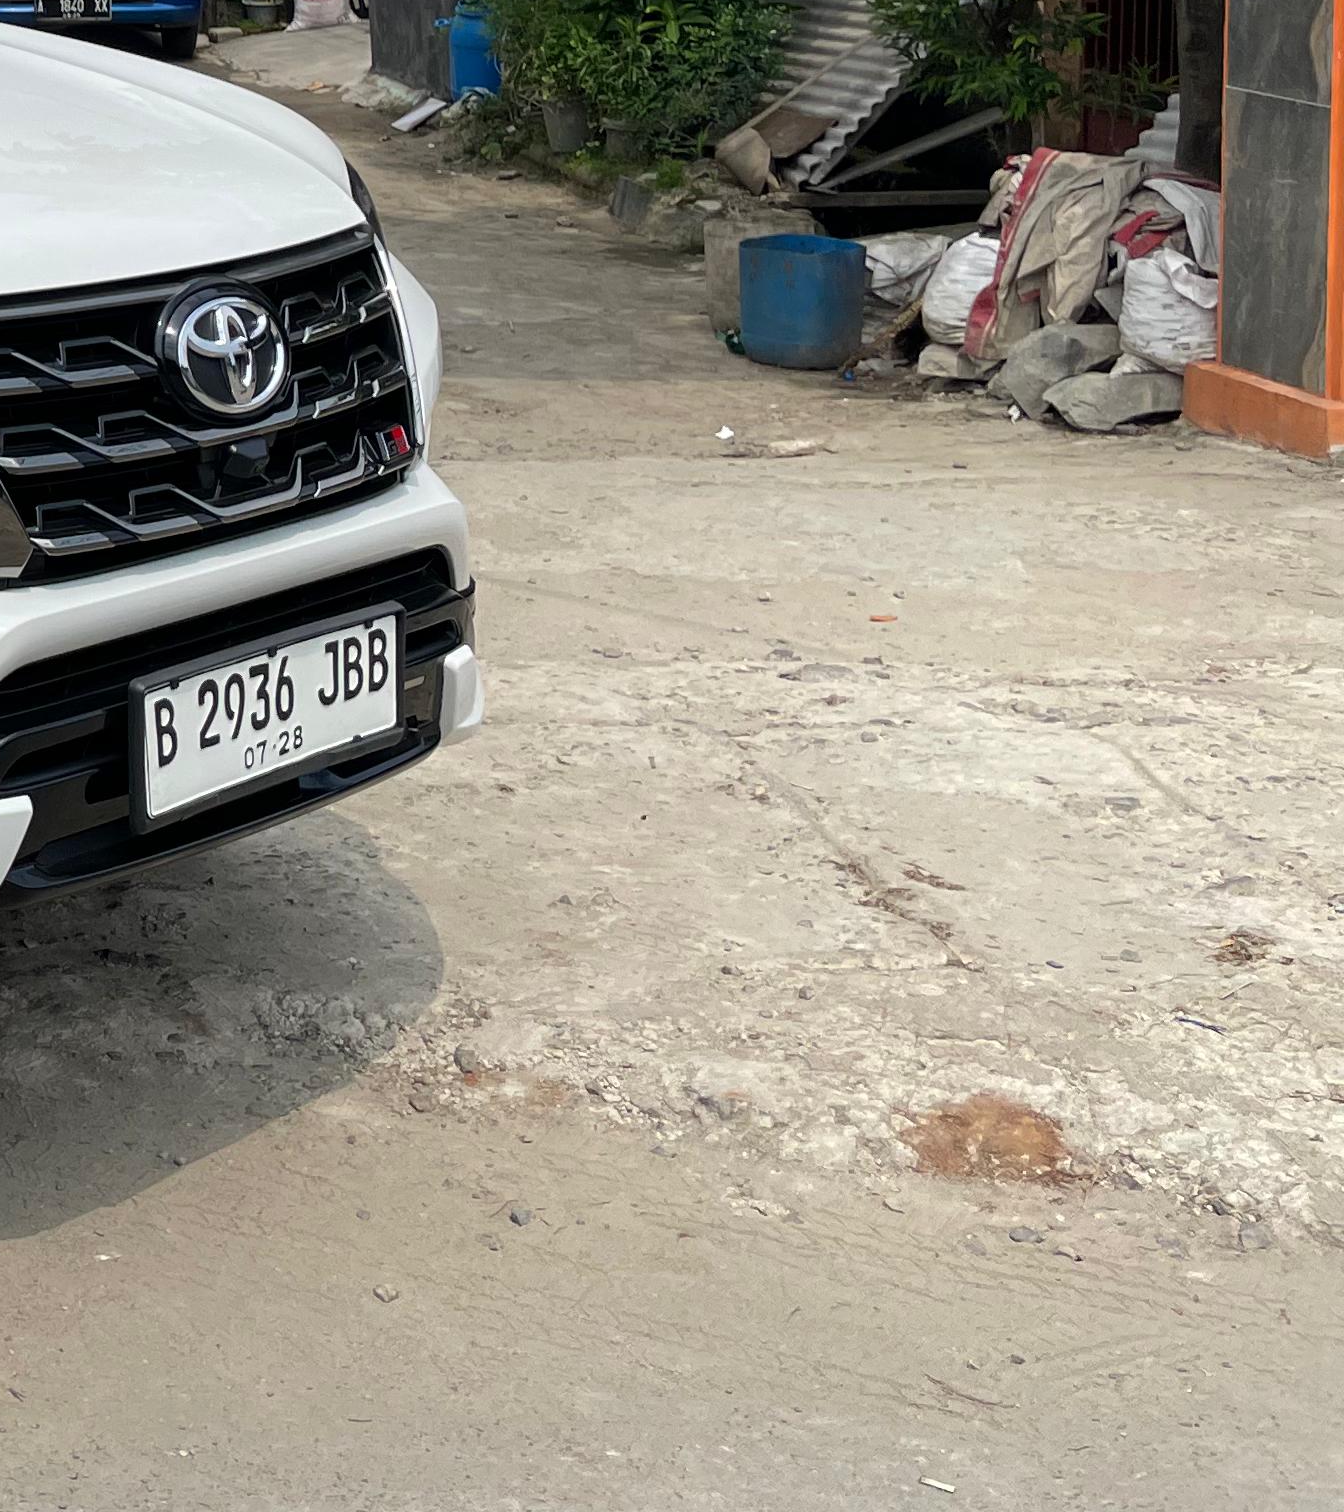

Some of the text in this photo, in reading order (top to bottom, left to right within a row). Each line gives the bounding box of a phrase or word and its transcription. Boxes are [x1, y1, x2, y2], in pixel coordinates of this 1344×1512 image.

[154, 628, 389, 768] B 2936 JBB
